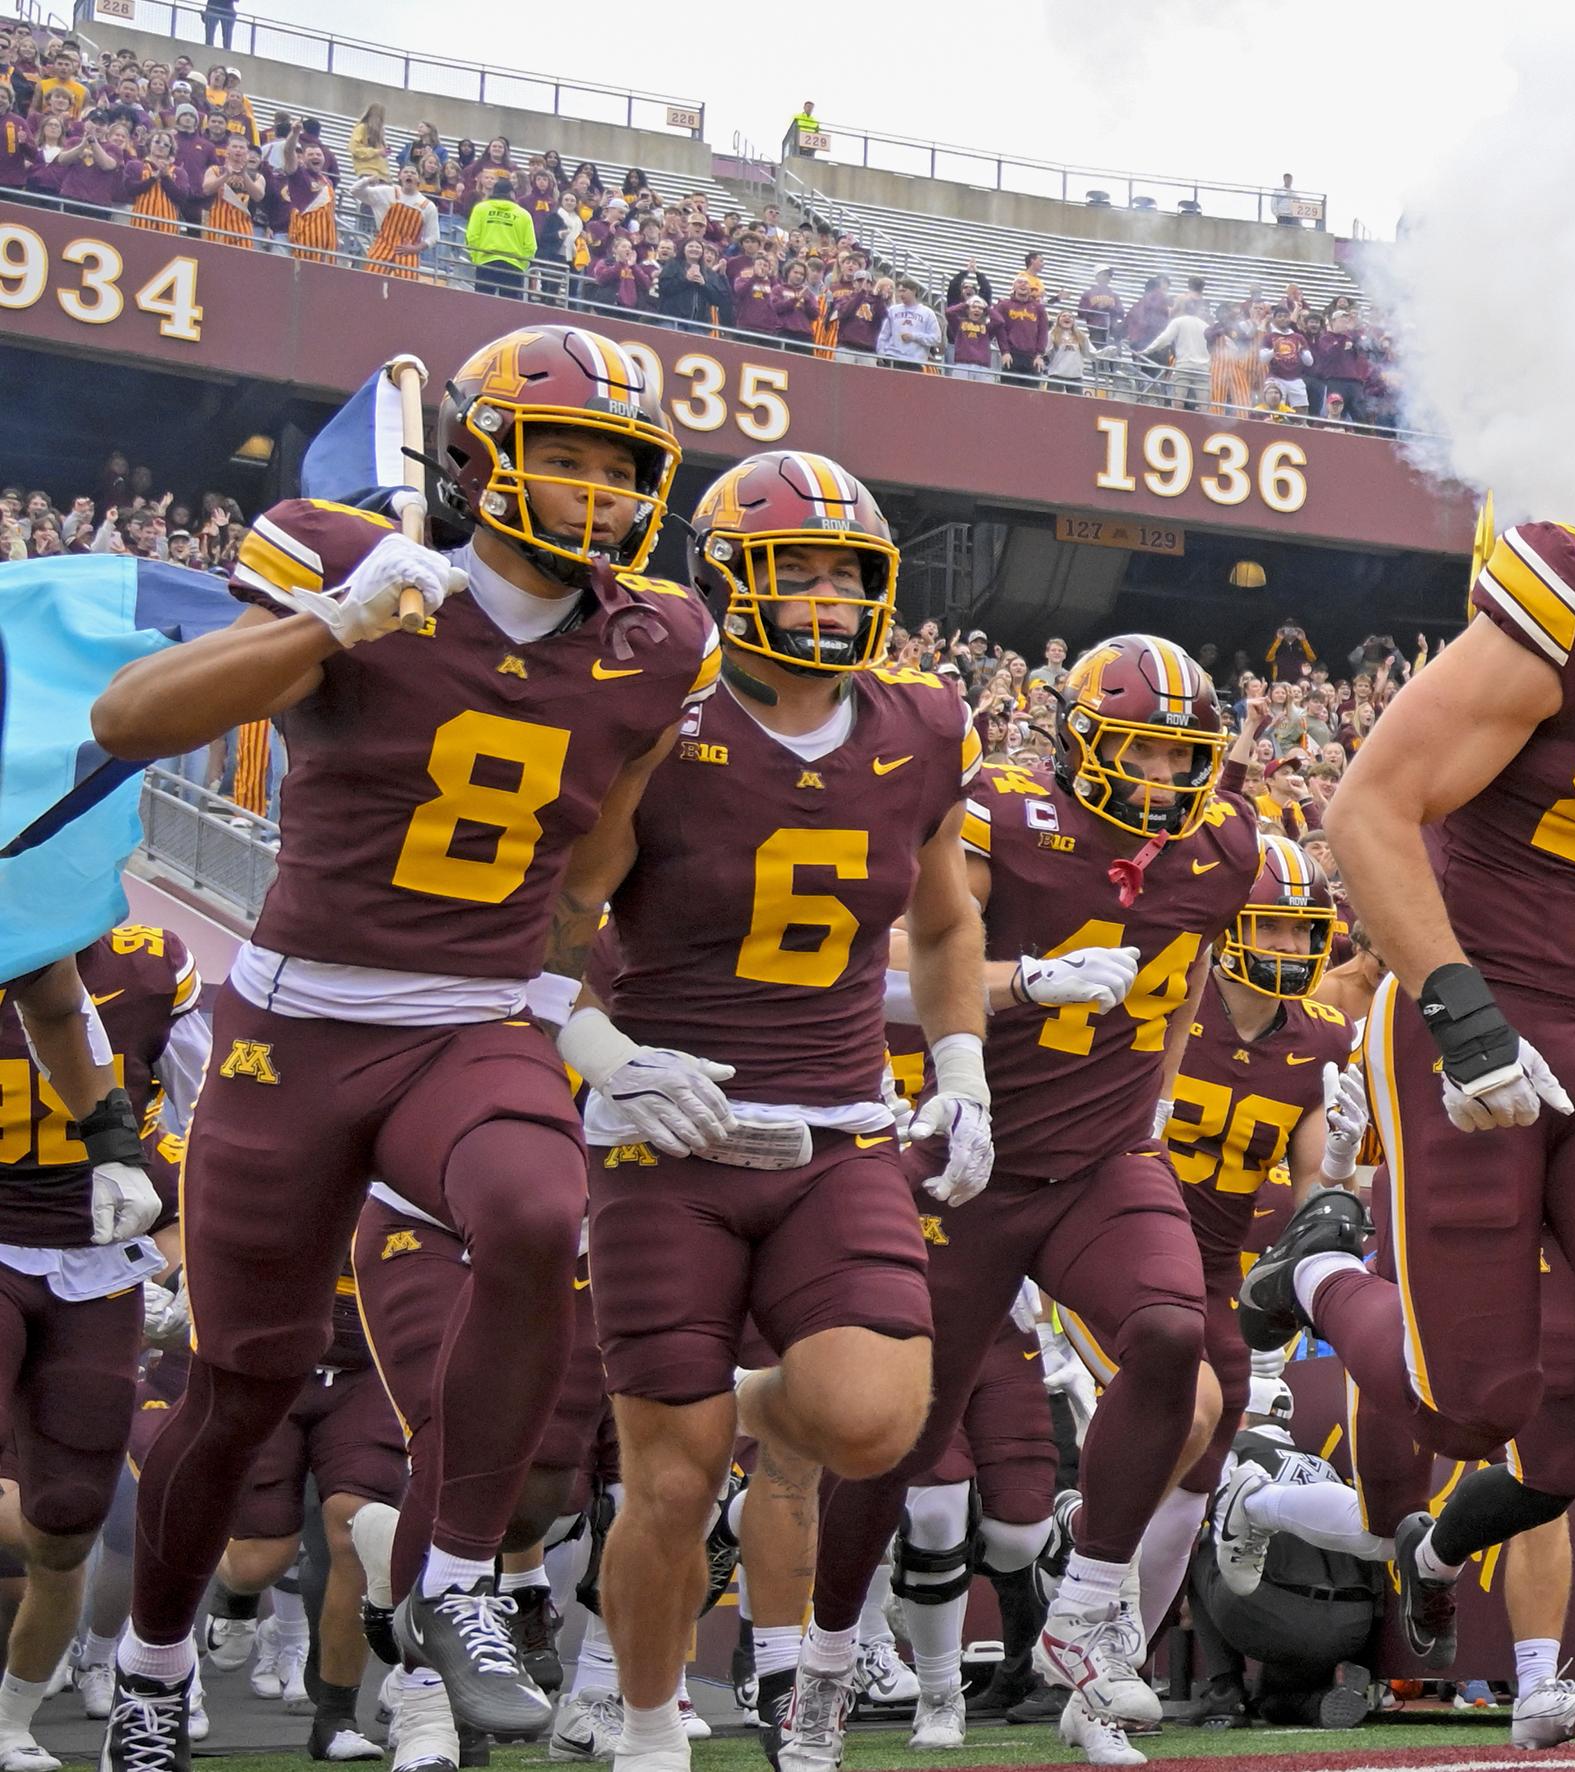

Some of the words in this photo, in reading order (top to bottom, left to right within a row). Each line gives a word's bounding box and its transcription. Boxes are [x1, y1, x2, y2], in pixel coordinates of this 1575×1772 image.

[671, 112, 695, 126] 228
[804, 134, 827, 148] 229
[1296, 205, 1319, 217] 229
[609, 399, 640, 419] ROW
[1096, 416, 1308, 513] 1936
[821, 518, 851, 532] ROW
[1065, 518, 1104, 540] 127
[1139, 527, 1177, 549] 129
[1165, 712, 1190, 727] ROW
[391, 708, 572, 905] 8
[735, 828, 870, 988] 6
[1288, 896, 1309, 907] ROW
[1038, 918, 1203, 1056] 44
[219, 1038, 282, 1086] M
